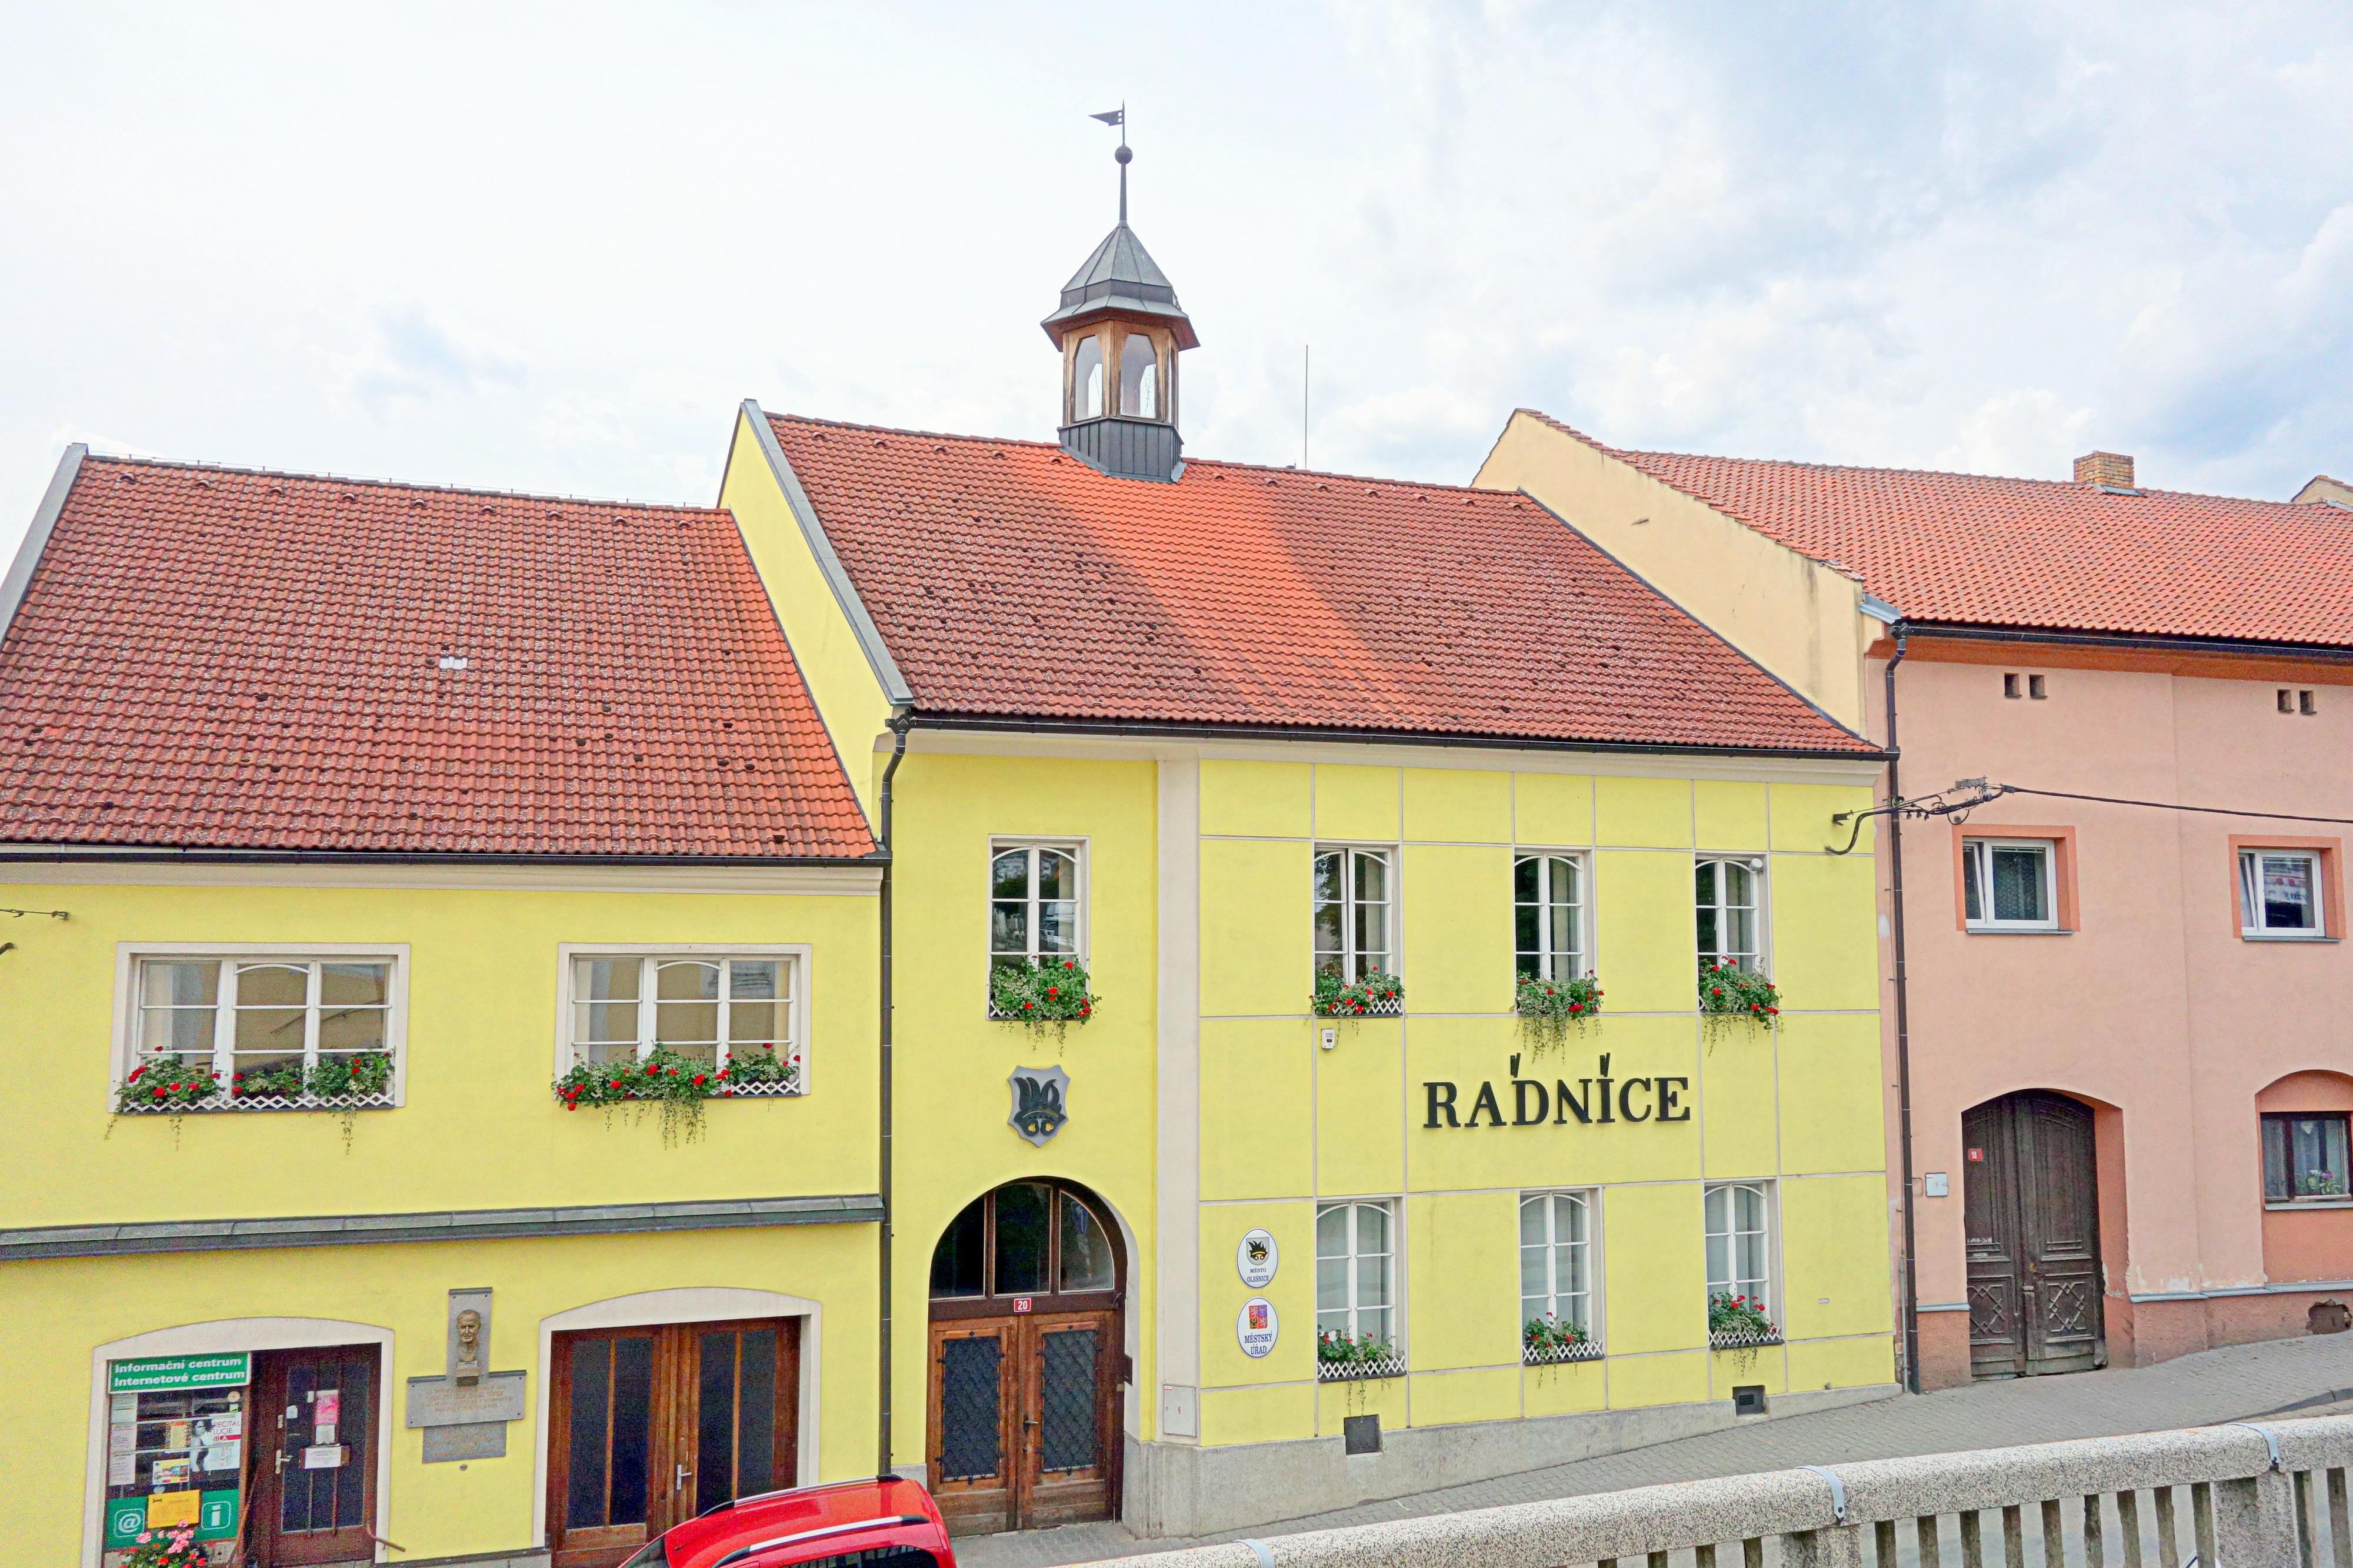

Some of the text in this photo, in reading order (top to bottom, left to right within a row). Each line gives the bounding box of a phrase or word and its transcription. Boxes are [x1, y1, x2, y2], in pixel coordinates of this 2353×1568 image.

[1018, 1300, 1028, 1310] 20
[1245, 1330, 1272, 1343] MĚSTSKÝ
[1251, 1344, 1267, 1355] ÚŘAD
[115, 1358, 242, 1373] Informační centrum
[114, 1370, 246, 1386] Internetové centrum
